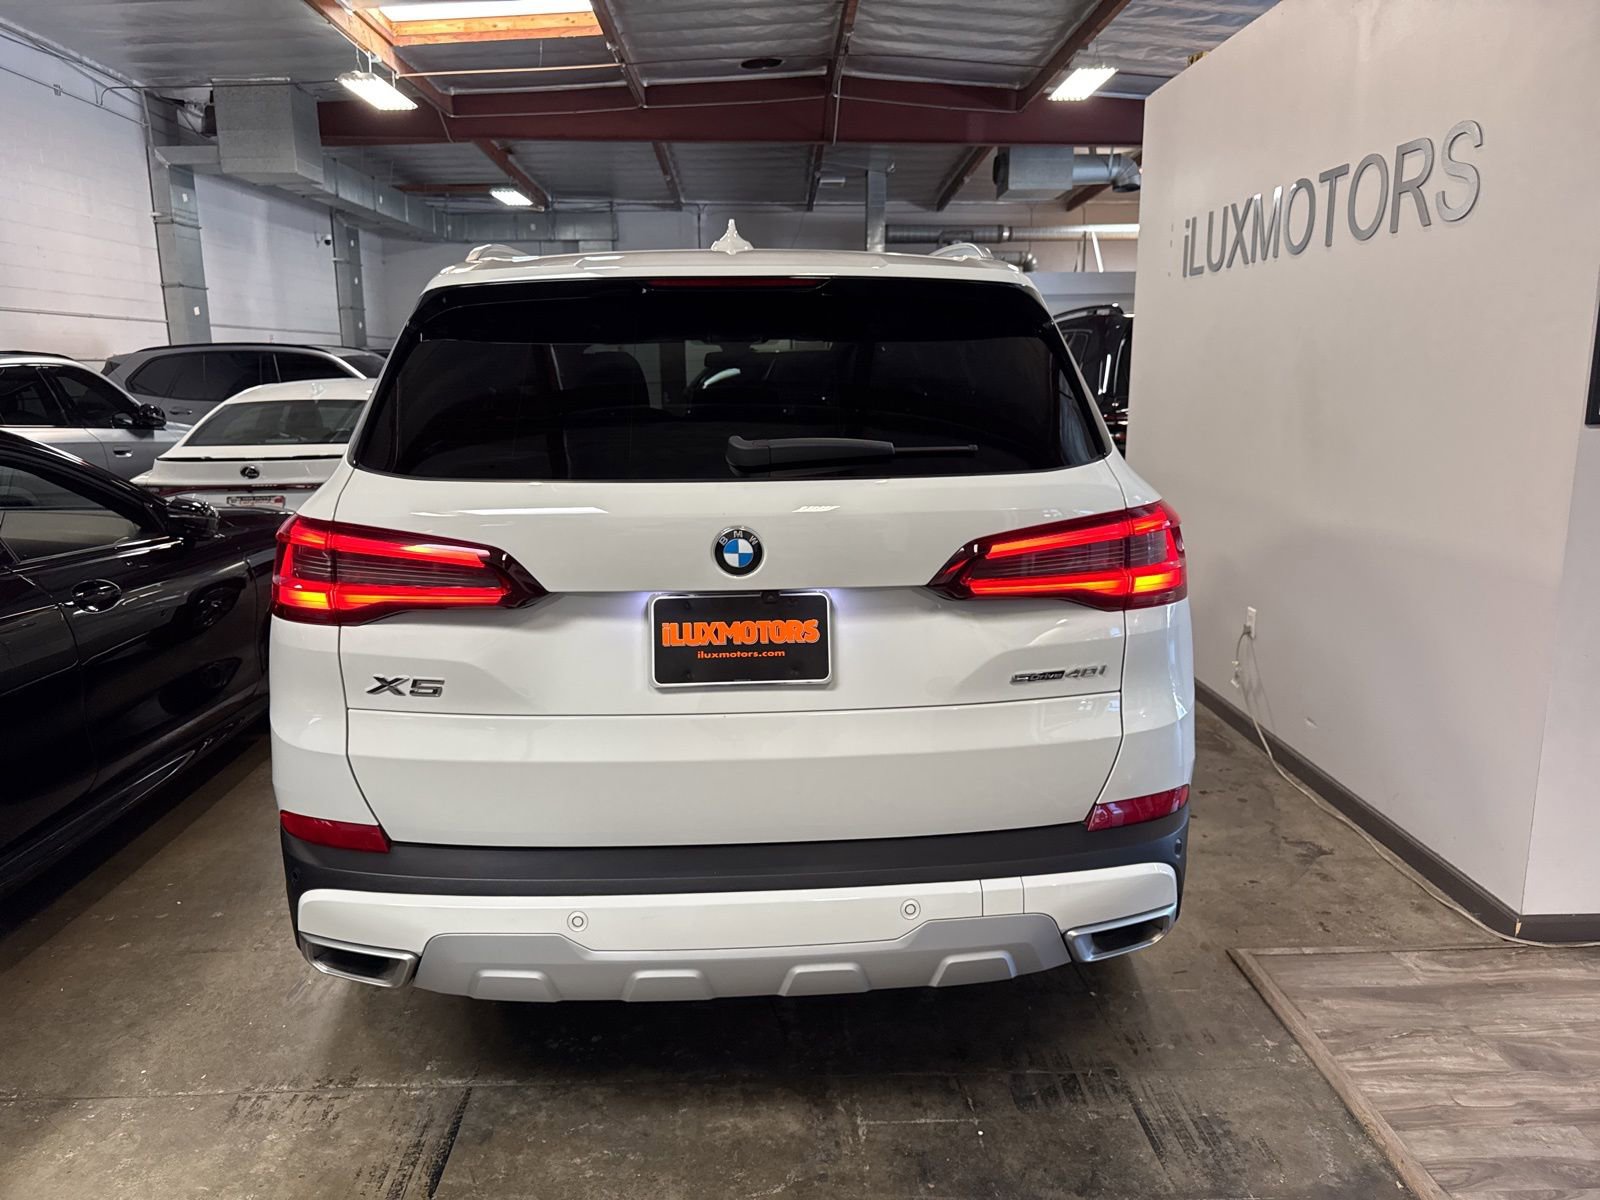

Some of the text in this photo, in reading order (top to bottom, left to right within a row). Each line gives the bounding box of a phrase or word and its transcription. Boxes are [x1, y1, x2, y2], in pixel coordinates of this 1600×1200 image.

[1182, 119, 1484, 278] iLUXMOTORS
[718, 530, 759, 546] BMW
[661, 619, 821, 647] iLUXMOTORS
[697, 650, 786, 659] iluxmotors.com
[365, 675, 446, 698] X5
